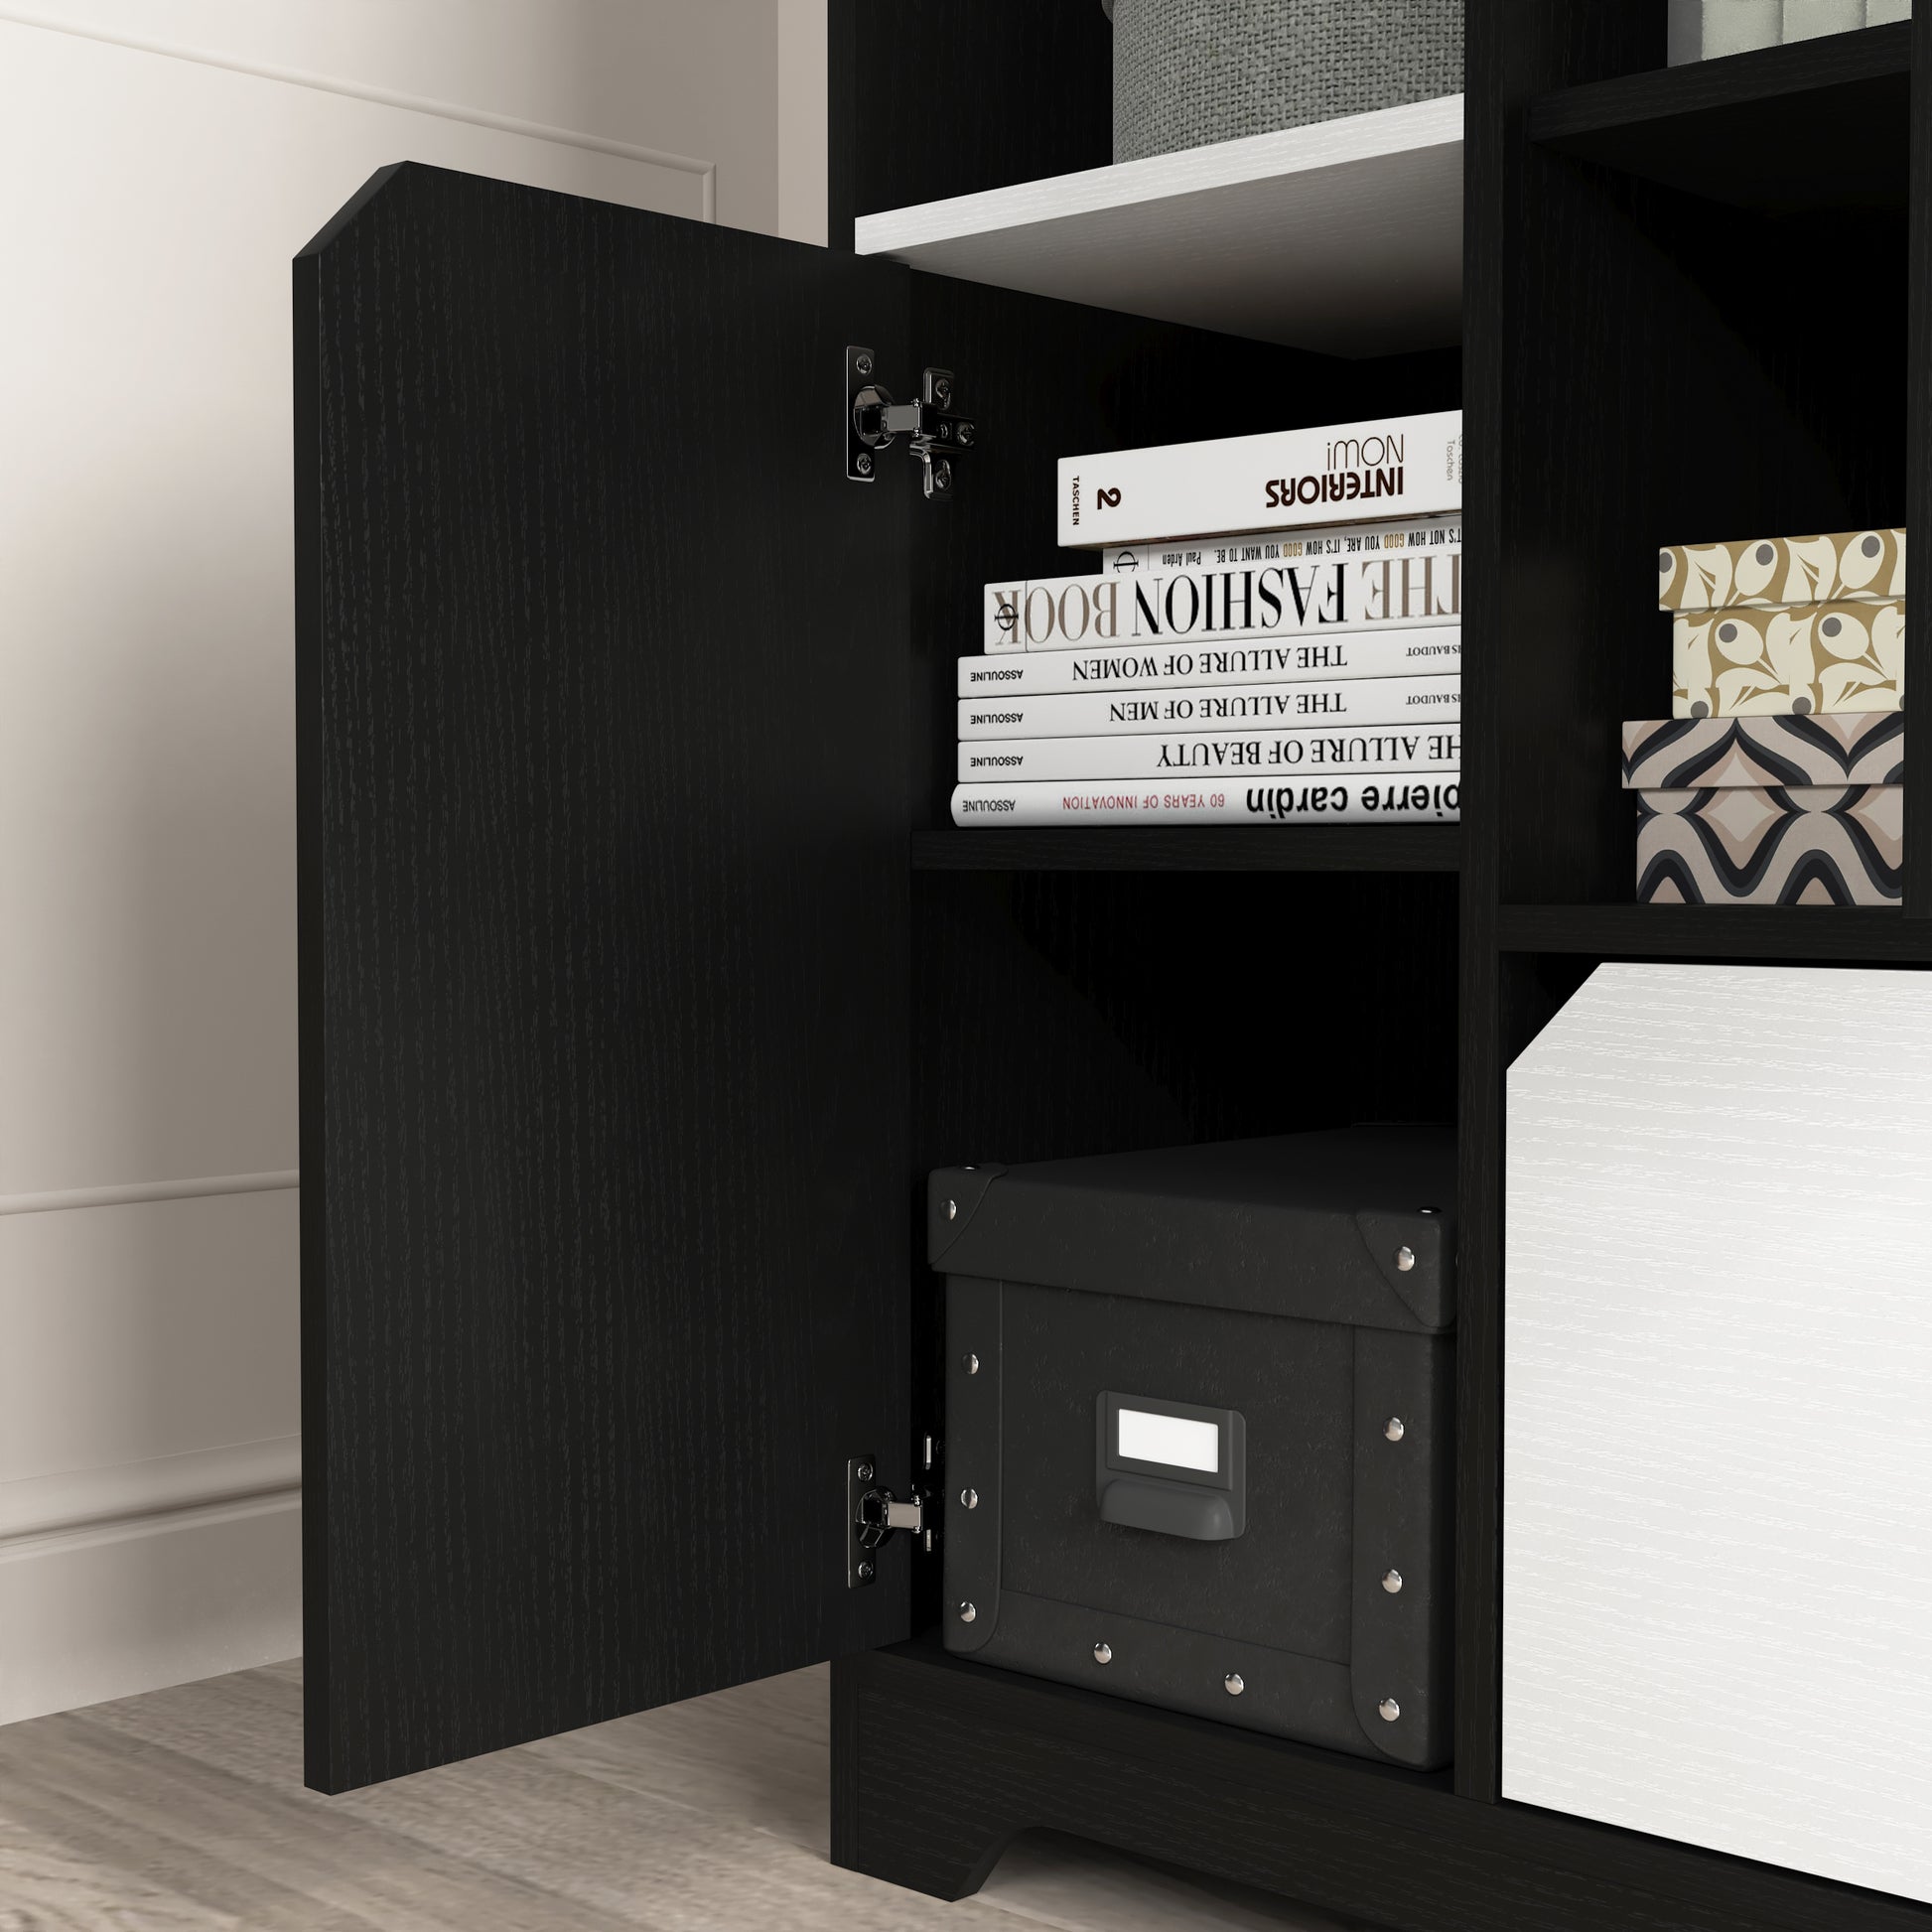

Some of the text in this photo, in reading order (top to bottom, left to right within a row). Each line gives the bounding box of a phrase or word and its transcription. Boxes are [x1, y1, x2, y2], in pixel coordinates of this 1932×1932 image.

[1327, 434, 1403, 471] NOW!
[1097, 487, 1121, 509] 2
[1266, 467, 1403, 508] INTERIORS
[1214, 528, 1461, 563] T'S NOT HOW GOOD YOU ARE, IT'S HOW GOOD YOU WANT TO BE.
[1162, 552, 1201, 567] Paul Arden
[992, 554, 1461, 645] THE FASHION BOOK
[1406, 645, 1449, 656] BAUDOT
[1073, 645, 1347, 680] THE ALLURE OF WOMEN
[971, 670, 1023, 682] ASSOULINE
[1110, 693, 1346, 721] THE ALLURE OF MEN
[1406, 694, 1449, 705] BAUDOT
[971, 713, 1023, 724] ASSOULINE
[971, 757, 1023, 766] ASSOULINE
[1157, 735, 1460, 766] HE ALLURE OF BEAUTY
[963, 800, 1016, 812] ASSOULINE
[1063, 794, 1224, 810] 60 YEARS OF INNOVATION
[1247, 782, 1461, 819] pierre cardin
